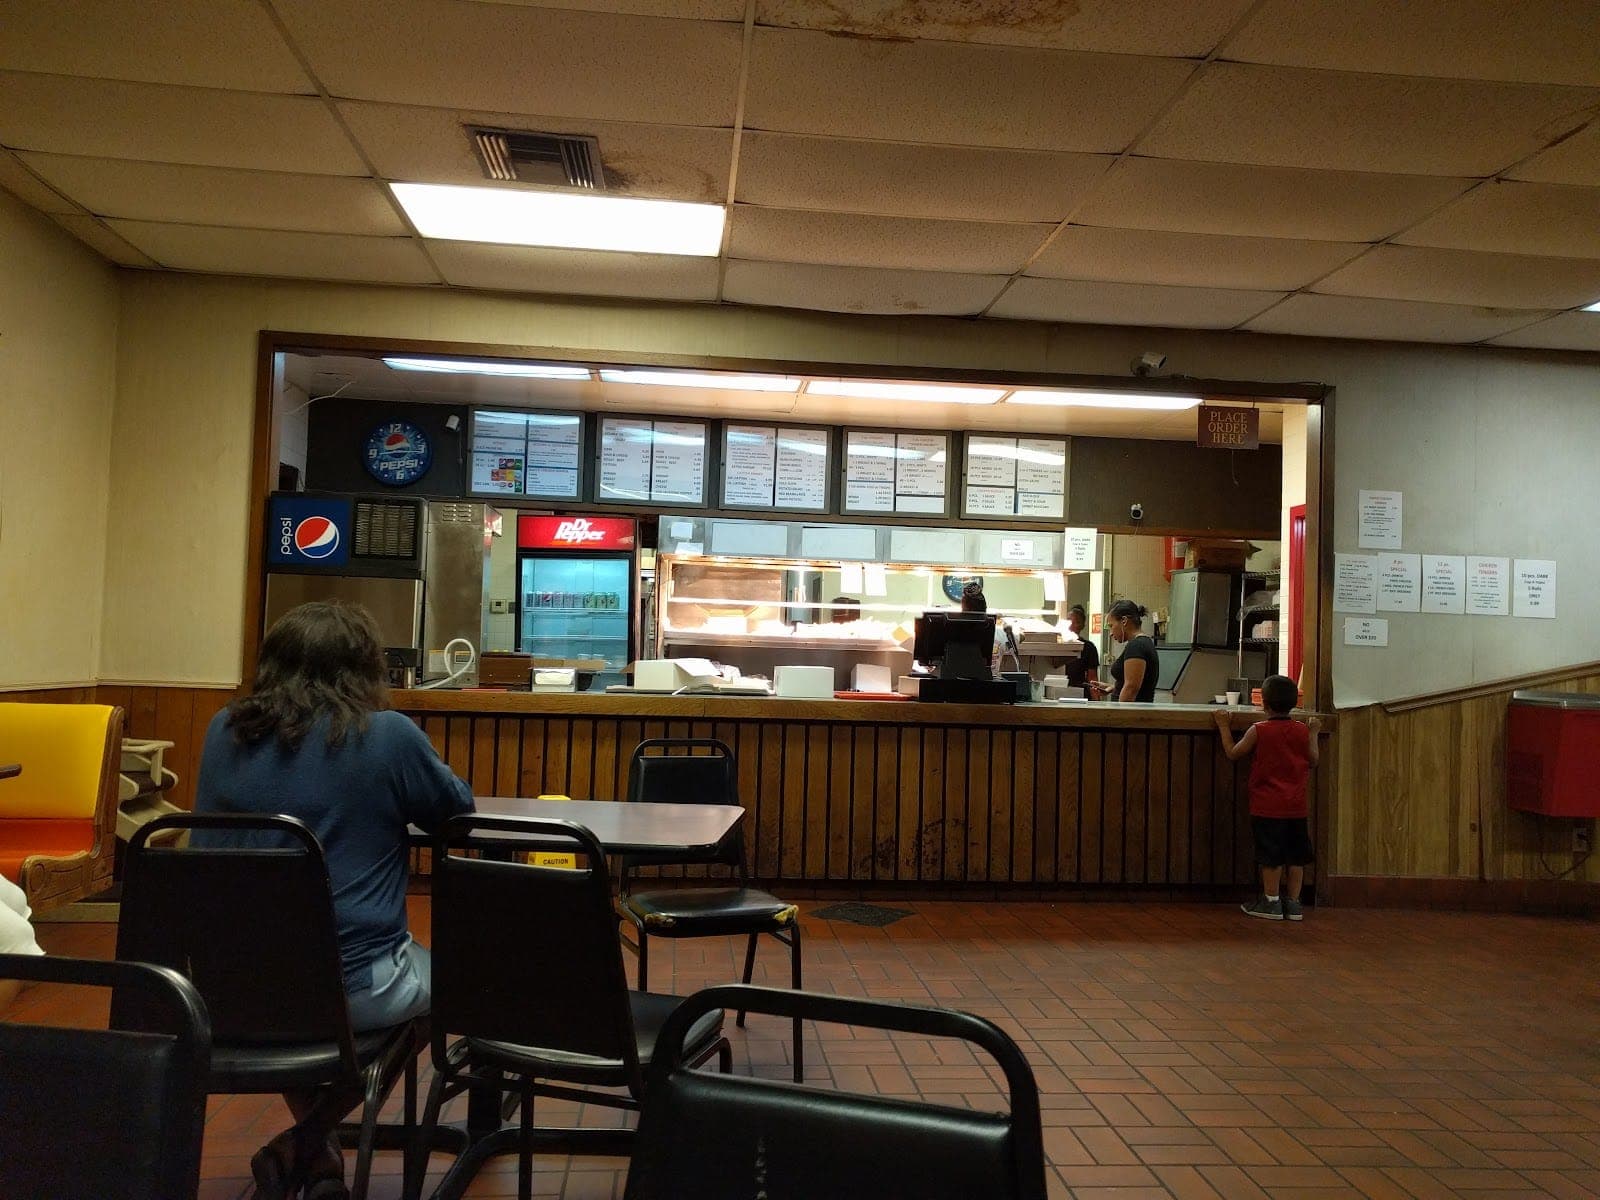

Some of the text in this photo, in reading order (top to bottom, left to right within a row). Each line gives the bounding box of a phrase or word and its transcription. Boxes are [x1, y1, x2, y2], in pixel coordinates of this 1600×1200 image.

[1210, 411, 1248, 423] PLACE
[389, 423, 401, 433] 12
[1208, 421, 1248, 434] ORDER
[1213, 433, 1245, 444] HERE
[367, 444, 425, 459] 9 3
[379, 459, 419, 471] PEPSI
[395, 469, 405, 480] 6
[574, 518, 593, 532] Dr
[280, 517, 293, 555] pepsi
[553, 521, 606, 544] Pepper
